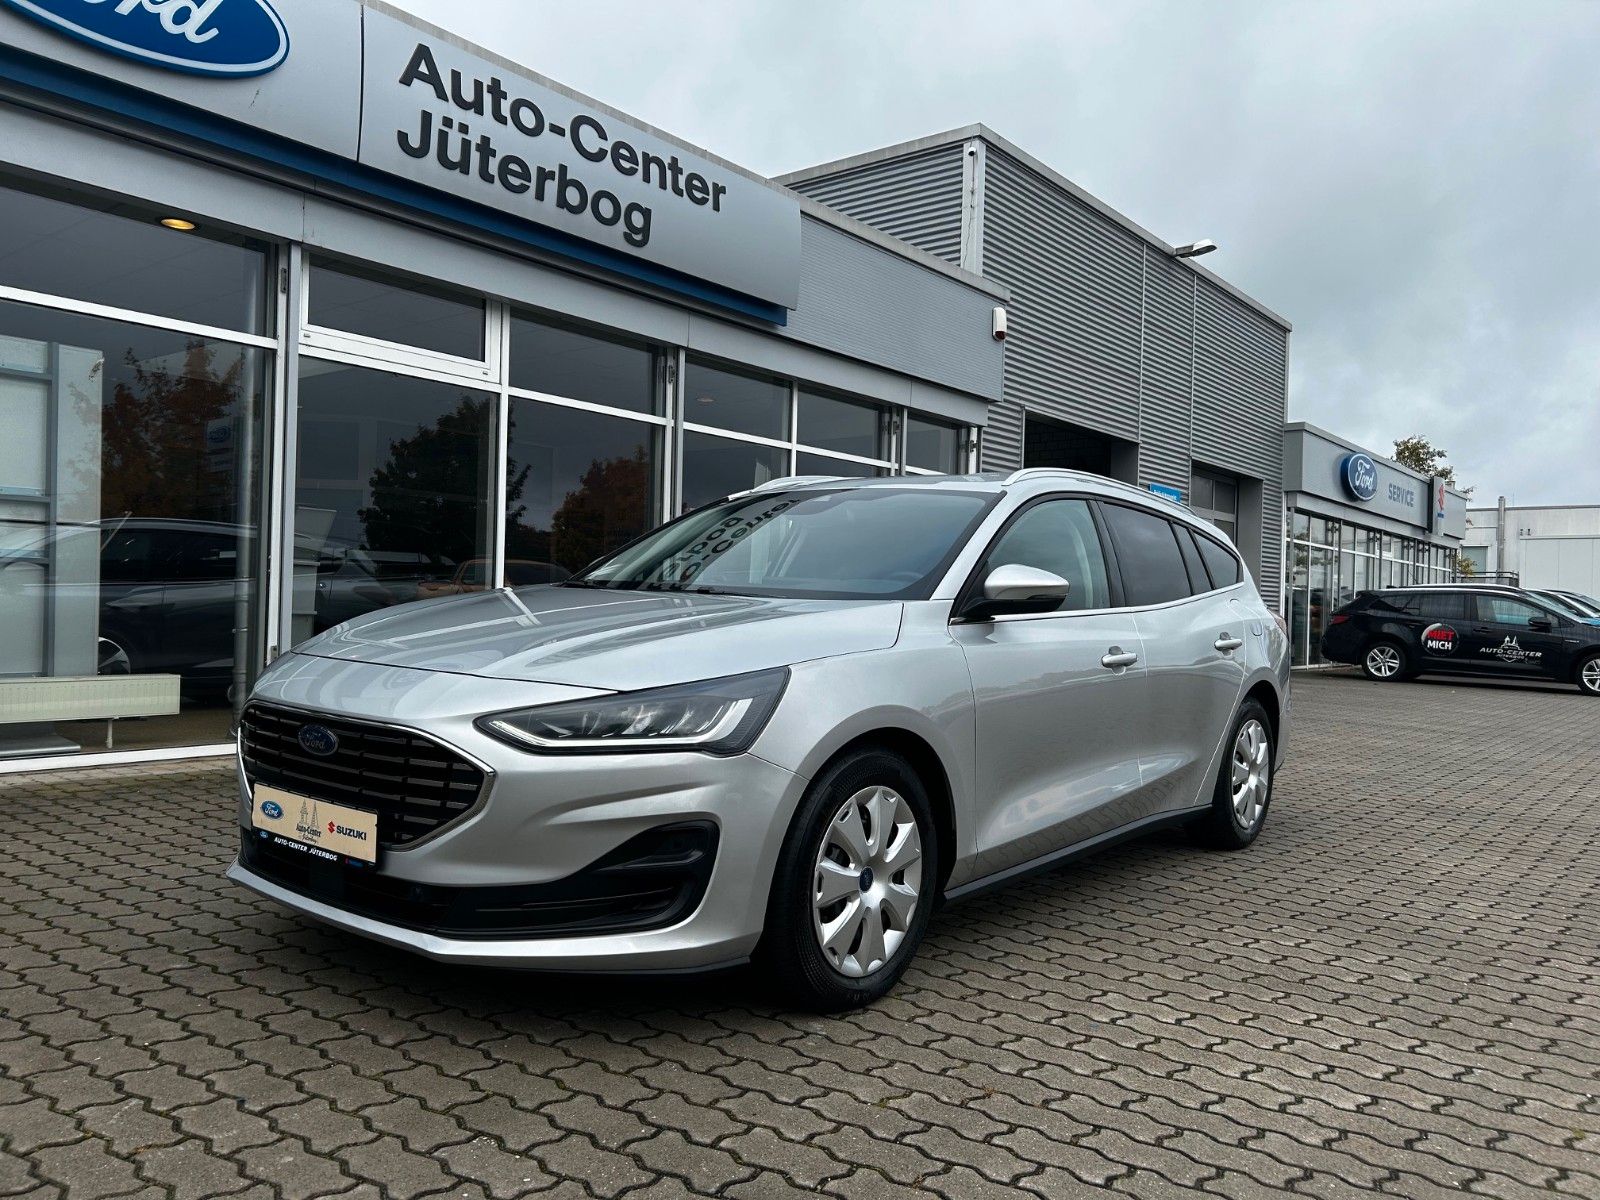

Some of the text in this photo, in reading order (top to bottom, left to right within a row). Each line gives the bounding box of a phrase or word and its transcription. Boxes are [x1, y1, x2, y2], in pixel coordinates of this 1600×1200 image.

[398, 42, 726, 213] Auto-Center
[396, 109, 653, 248] Jüterbog
[1355, 459, 1375, 490] Ford
[1388, 483, 1414, 507] SERVICE
[1427, 628, 1454, 640] MIET
[1427, 640, 1452, 650] MICH
[264, 803, 279, 817] Ford
[336, 825, 367, 841] SUZUKI
[273, 836, 307, 852] AUTO-CENTER
[308, 846, 338, 861] JÜTERBOG
